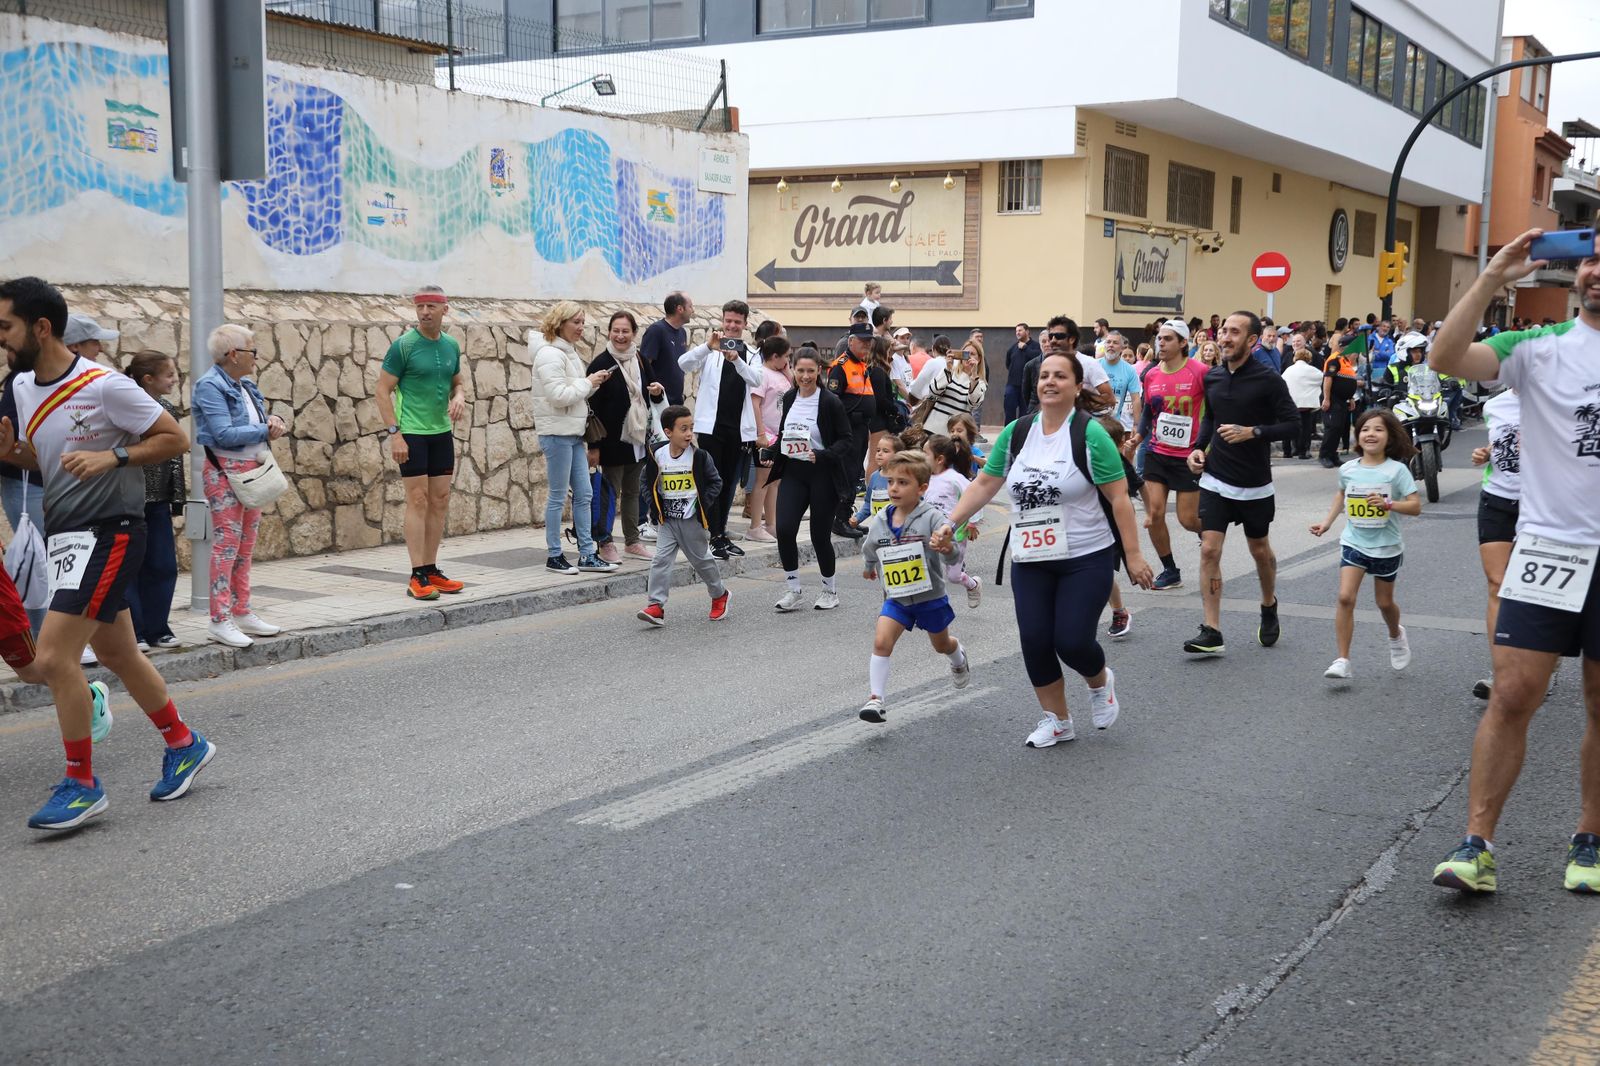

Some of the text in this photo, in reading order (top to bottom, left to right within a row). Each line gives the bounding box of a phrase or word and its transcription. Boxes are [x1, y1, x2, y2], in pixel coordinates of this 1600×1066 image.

[779, 196, 800, 212] LE
[790, 190, 915, 262] Grand
[904, 230, 946, 246] CAFÉ
[1132, 246, 1169, 292] Grand
[1162, 425, 1185, 438] 840
[786, 442, 808, 454] 212
[664, 479, 692, 490] 1073
[1350, 504, 1385, 517] 1058
[1022, 528, 1056, 548] 256
[885, 566, 922, 586] 1012
[1520, 562, 1576, 590] 877
